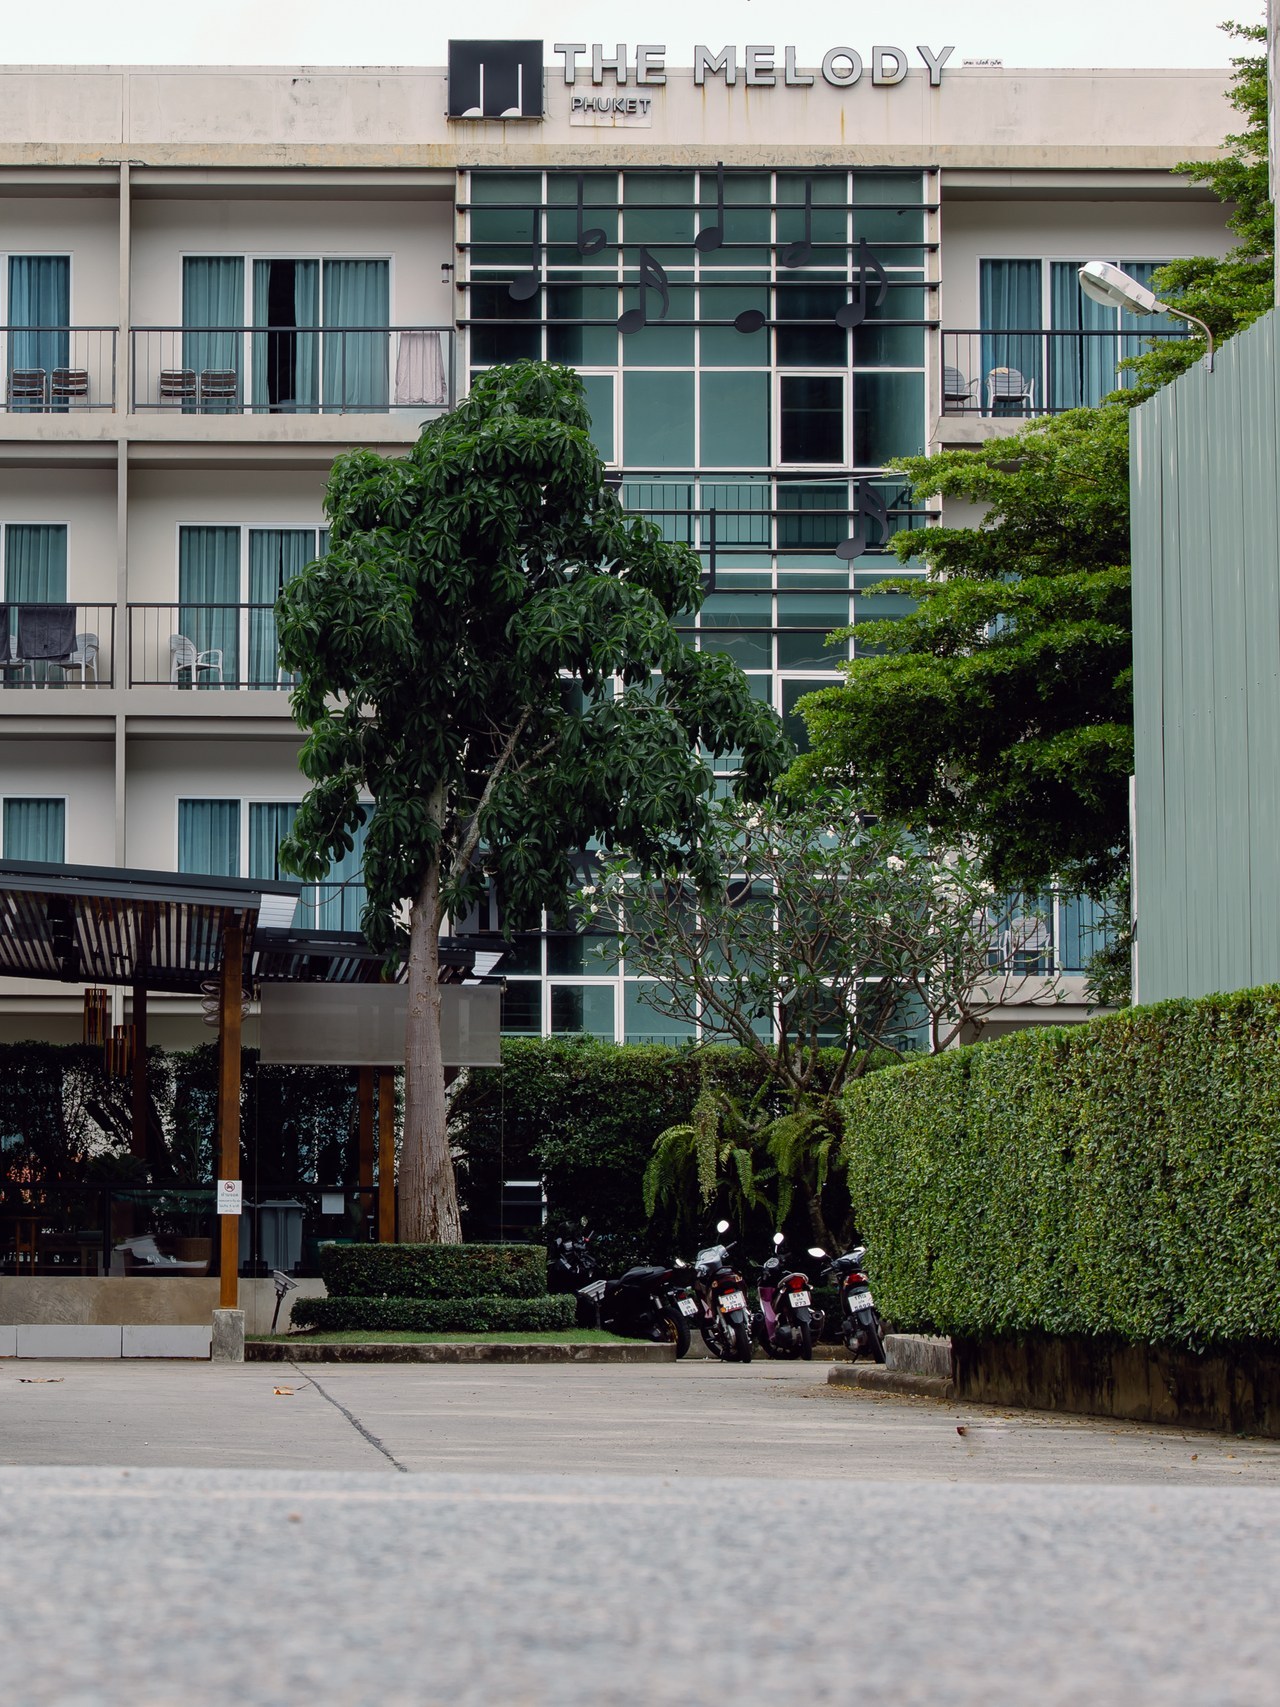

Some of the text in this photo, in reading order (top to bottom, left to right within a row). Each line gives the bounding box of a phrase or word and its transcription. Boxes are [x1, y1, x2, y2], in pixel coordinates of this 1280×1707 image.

[554, 43, 956, 88] THE MELODY
[571, 96, 651, 114] PHUKET
